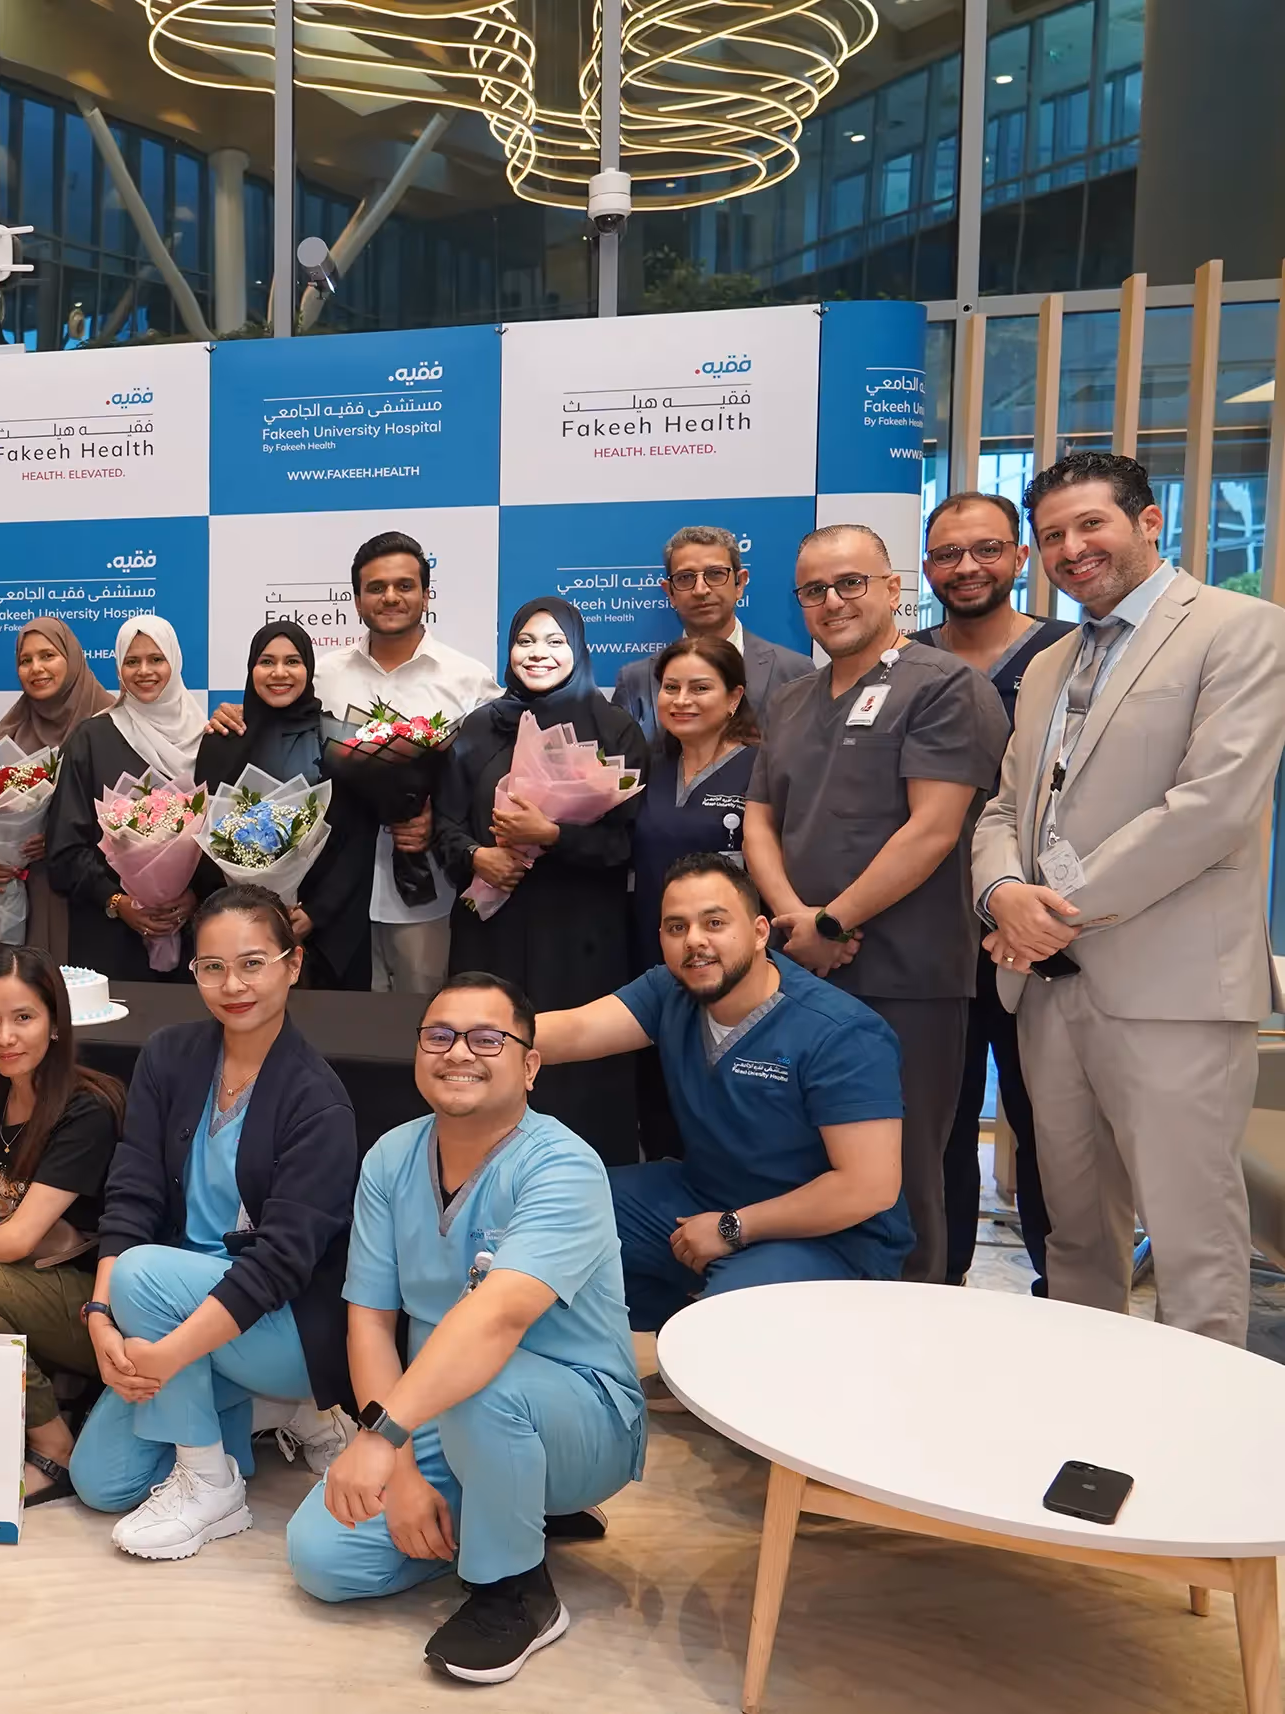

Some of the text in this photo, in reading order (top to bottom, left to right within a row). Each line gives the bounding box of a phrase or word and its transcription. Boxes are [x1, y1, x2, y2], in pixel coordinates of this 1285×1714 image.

[264, 398, 442, 425] مستشفى فقيه الجامعي
[864, 400, 911, 413] Fakeeh
[562, 412, 751, 437] Fakeeh Health
[864, 417, 876, 427] By
[878, 416, 907, 426] Fakeeh
[262, 420, 442, 440] Fakeeh University Hospital
[81, 439, 154, 458] Health
[262, 441, 336, 453] By Fakeeh Health
[594, 444, 717, 458] HEALTH. ELEVATED.
[22, 468, 125, 481] HEALTH. ELEVATED.
[287, 466, 420, 480] WWW.FAKEEH.HEALTH
[557, 574, 618, 595] الجامعي
[47, 586, 85, 602] فقيه
[88, 584, 156, 602] مستشفى
[39, 608, 100, 622] University
[103, 606, 156, 619] Hospital
[265, 609, 347, 625] Fakeeh
[605, 613, 634, 622] Health
